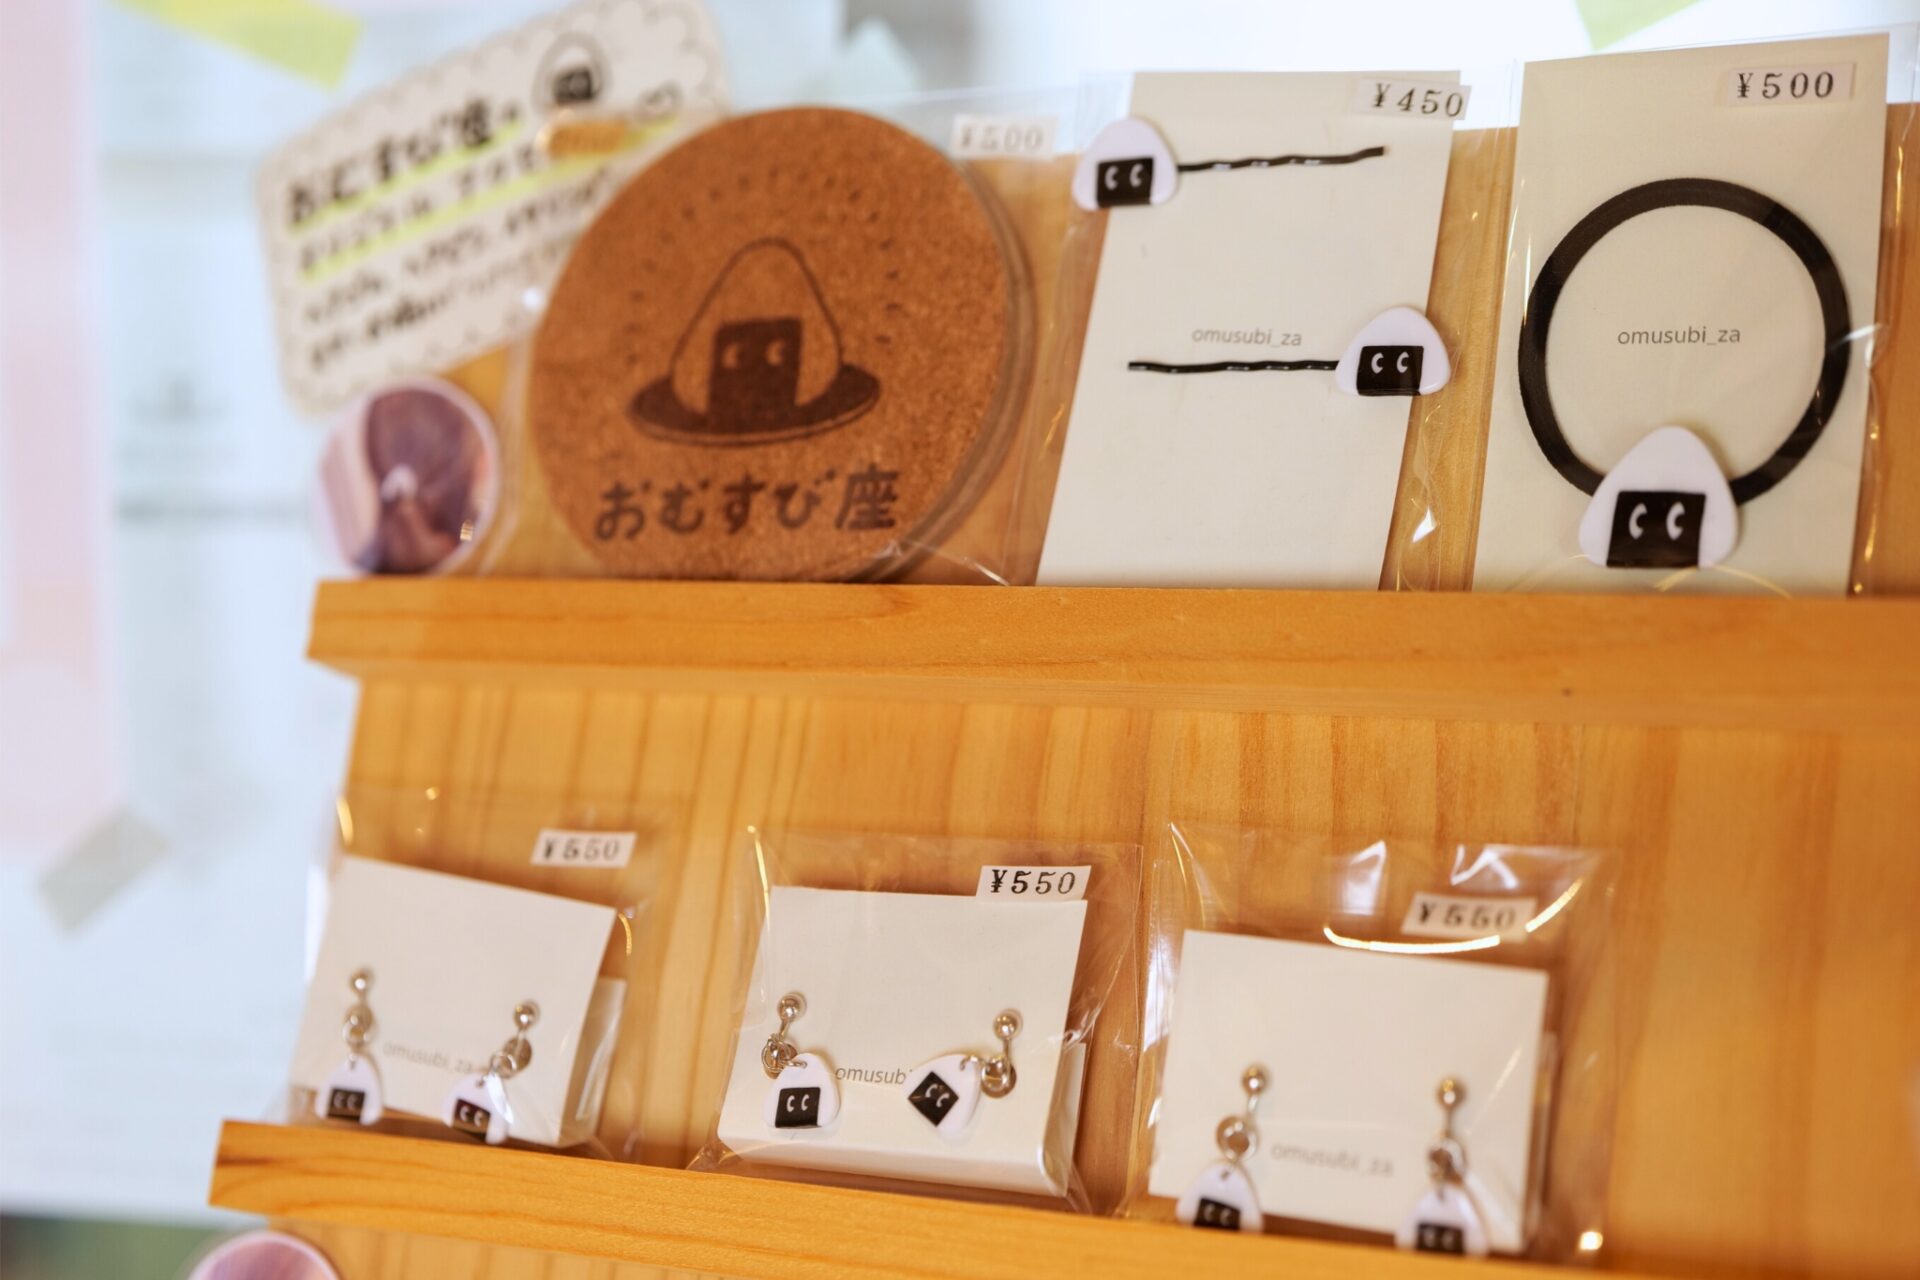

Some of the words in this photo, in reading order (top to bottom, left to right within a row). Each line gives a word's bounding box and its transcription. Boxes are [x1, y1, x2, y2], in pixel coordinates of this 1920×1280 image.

[1737, 71, 1834, 99] ¥500
[1372, 82, 1463, 117] ¥450
[1192, 326, 1303, 348] omusubi_za
[1618, 325, 1741, 346] omusubi_za
[594, 462, 899, 541] おむすび座
[990, 869, 1076, 895] ¥550
